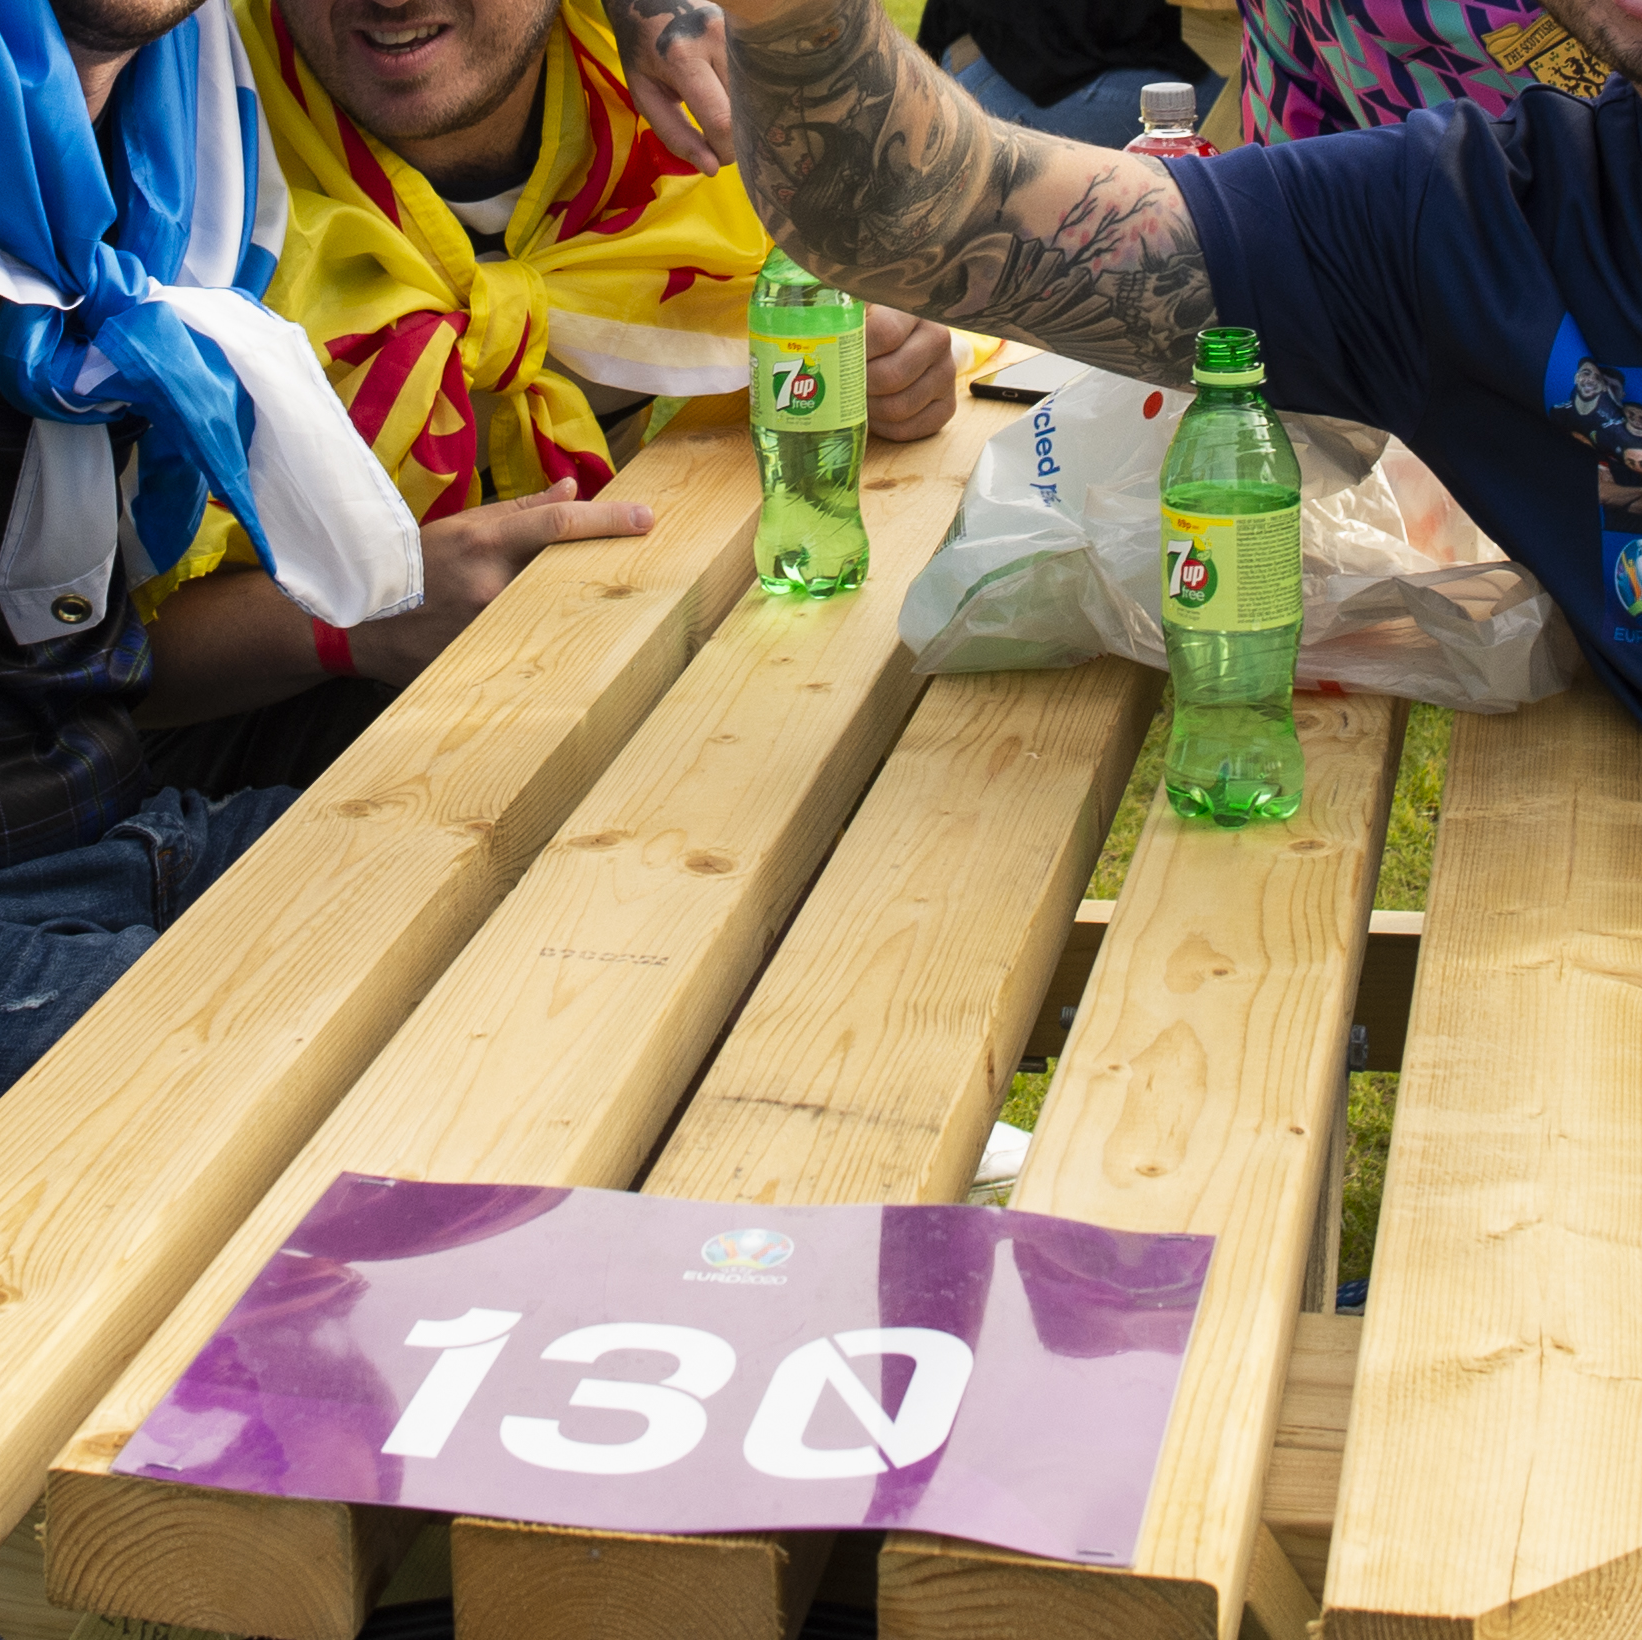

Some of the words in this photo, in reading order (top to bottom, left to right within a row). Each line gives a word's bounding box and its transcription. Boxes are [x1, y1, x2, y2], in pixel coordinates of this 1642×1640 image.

[791, 398, 816, 410] free
[1182, 586, 1206, 602] free
[379, 1307, 975, 1480] 130
